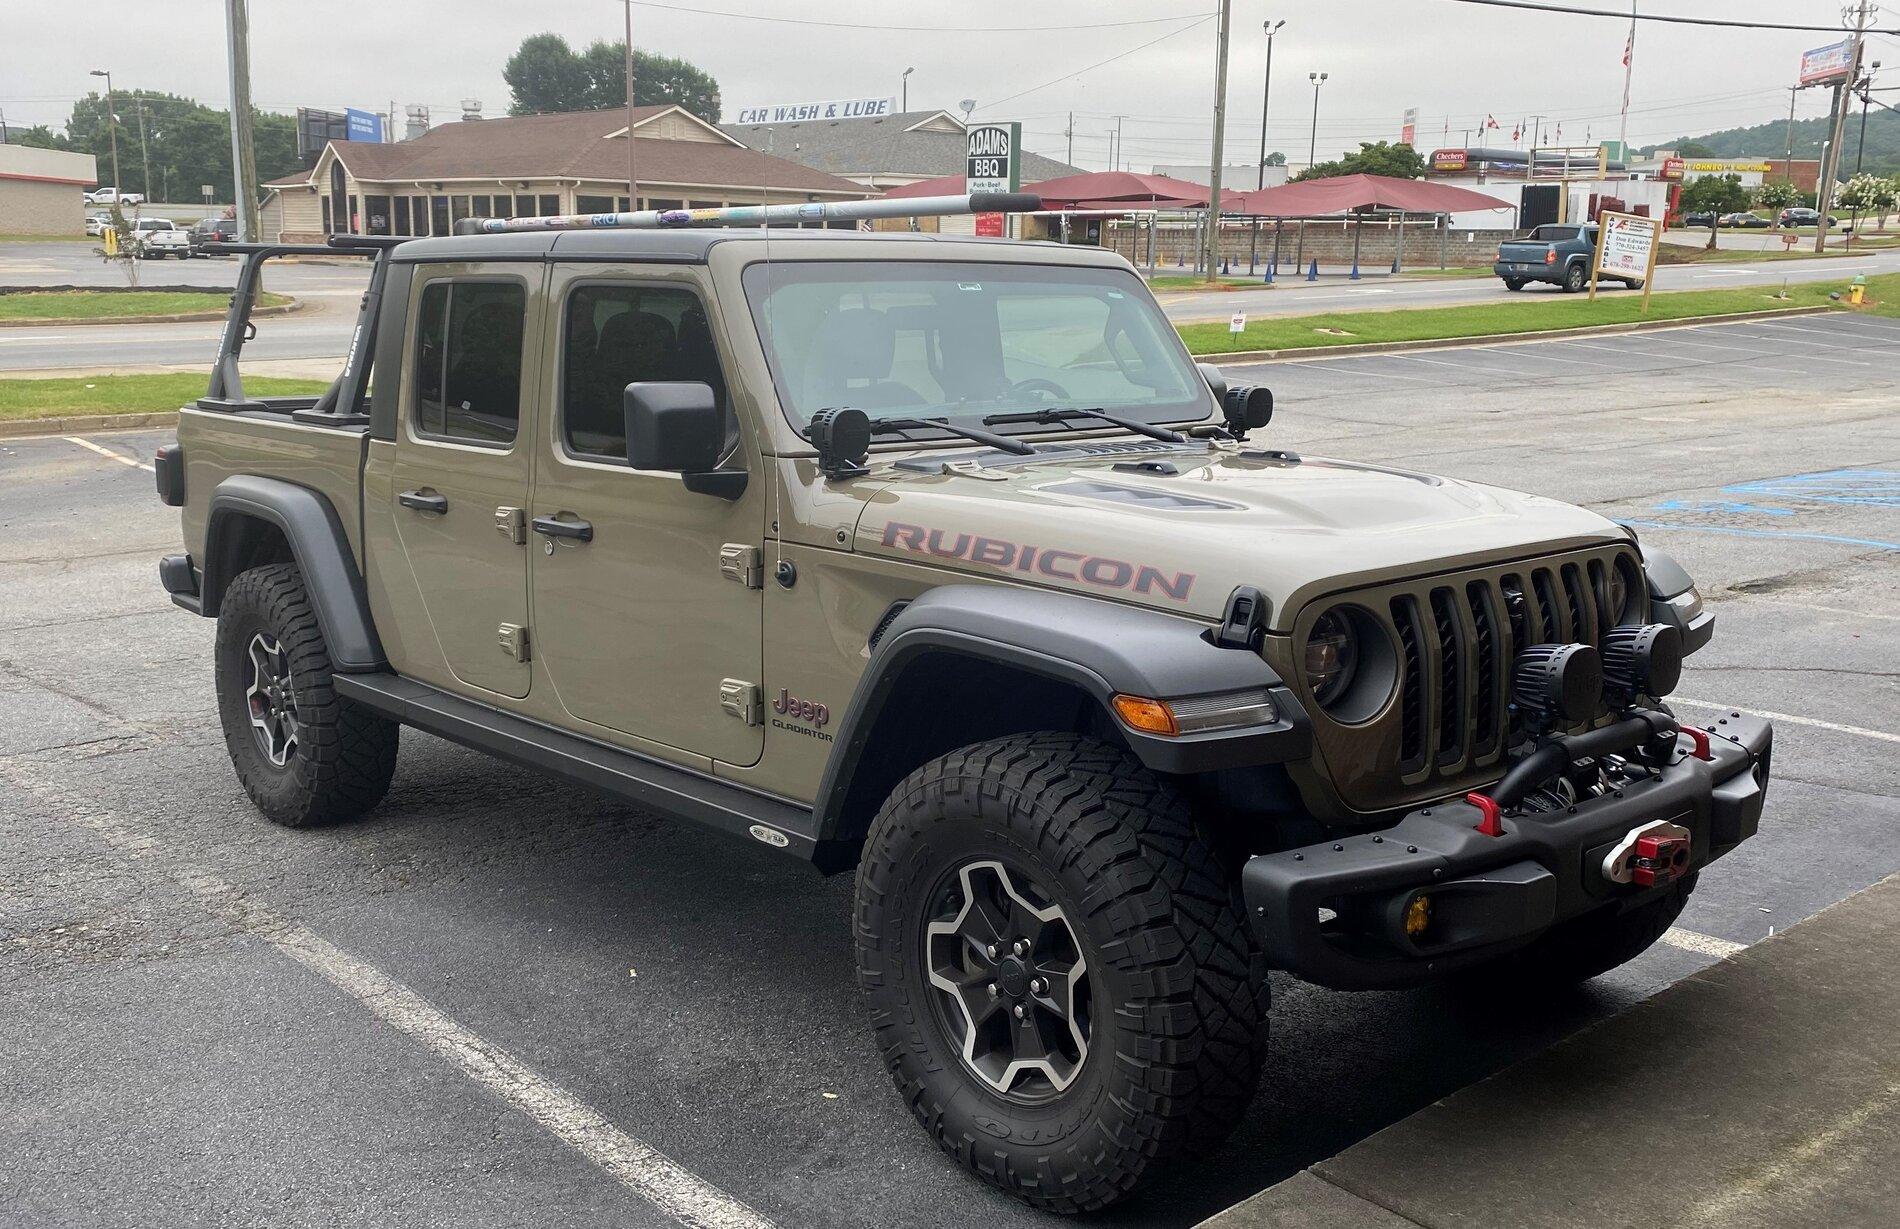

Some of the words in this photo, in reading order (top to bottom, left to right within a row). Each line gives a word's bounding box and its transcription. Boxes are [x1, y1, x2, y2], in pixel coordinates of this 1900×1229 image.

[738, 109, 768, 124] CAR
[774, 105, 819, 121] WASH
[825, 104, 837, 118] &
[843, 100, 888, 117] LUBE
[968, 129, 1008, 156] ADAMS
[975, 159, 999, 177] BBQ
[1436, 152, 1464, 160] Checkers
[1602, 216, 1615, 268] AVAILABLE
[880, 520, 1197, 602] RUBICON
[772, 687, 830, 729] Jeep
[772, 718, 834, 743] GLADIATOR
